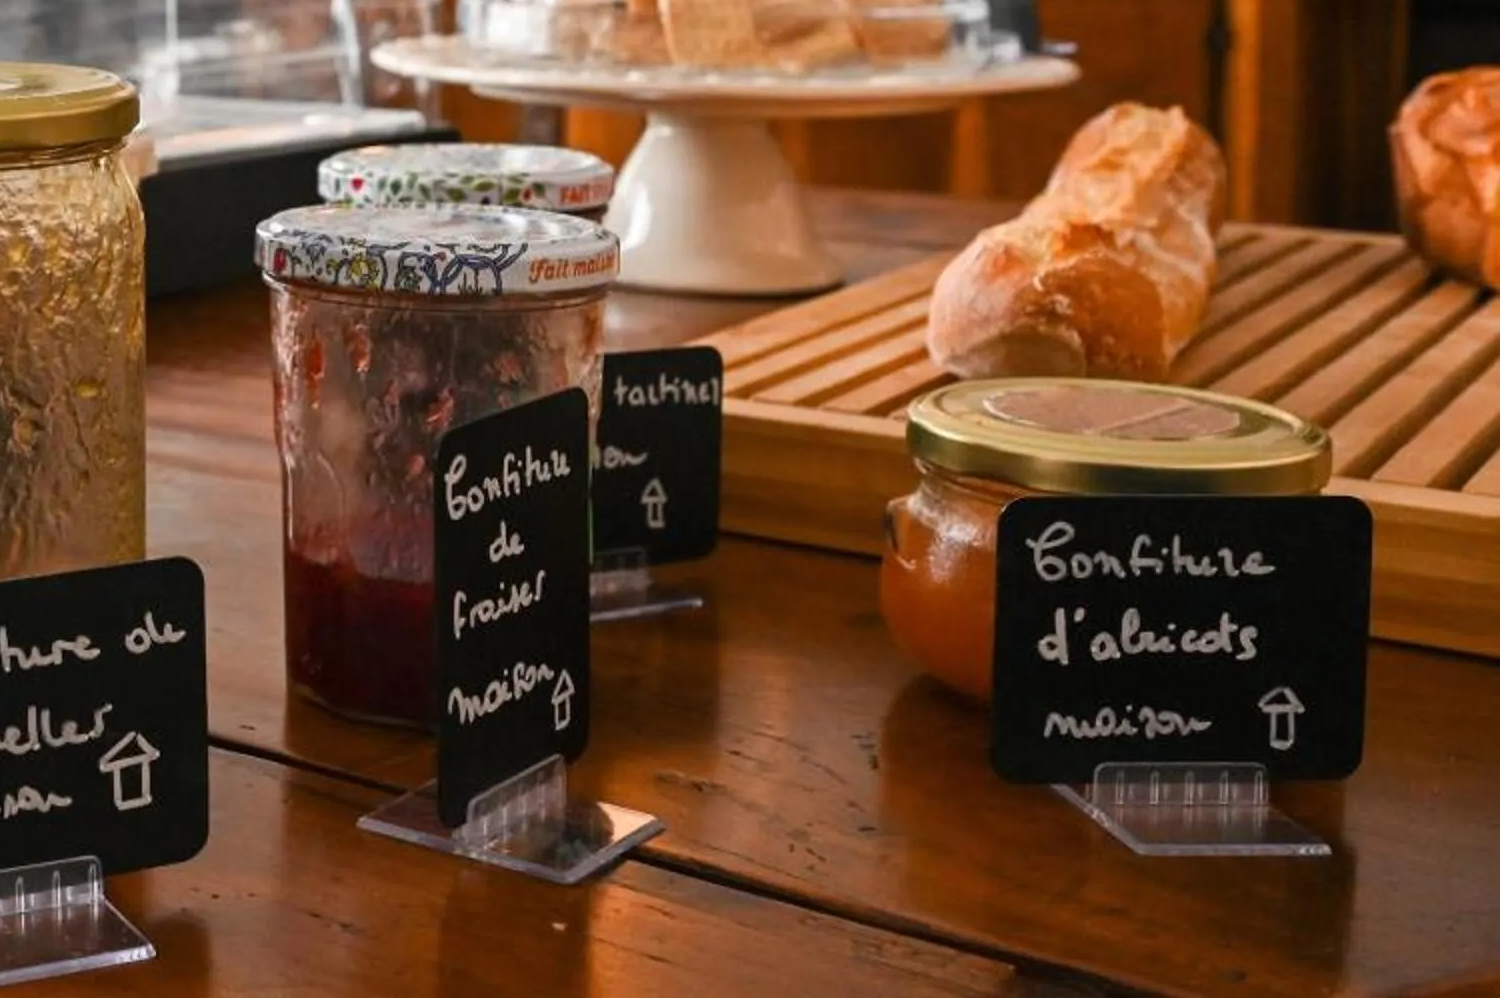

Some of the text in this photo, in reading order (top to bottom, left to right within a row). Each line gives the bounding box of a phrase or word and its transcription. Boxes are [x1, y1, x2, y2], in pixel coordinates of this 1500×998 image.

[528, 256, 569, 283] Fait
[444, 445, 572, 521] Confiture
[488, 522, 525, 563] de
[1025, 520, 1277, 582] Confiture
[124, 610, 187, 656] de
[447, 660, 555, 728] maison
[1042, 705, 1213, 740] maison
